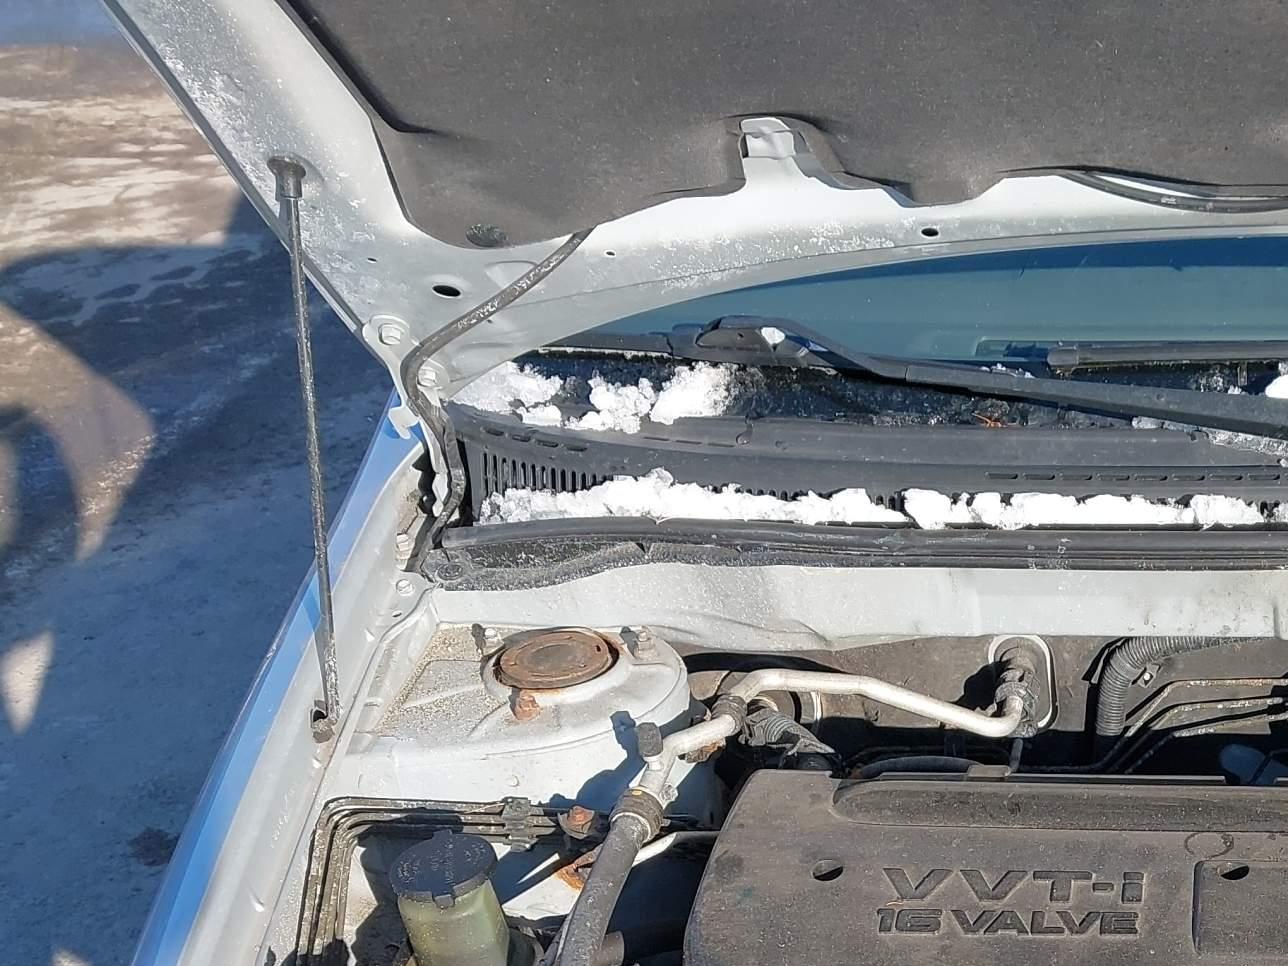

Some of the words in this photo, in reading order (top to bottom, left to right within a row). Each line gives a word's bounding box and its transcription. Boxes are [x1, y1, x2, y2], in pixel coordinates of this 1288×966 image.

[882, 867, 1146, 904] VVT-i
[876, 908, 943, 936] 16
[949, 909, 1140, 937] VALVE
